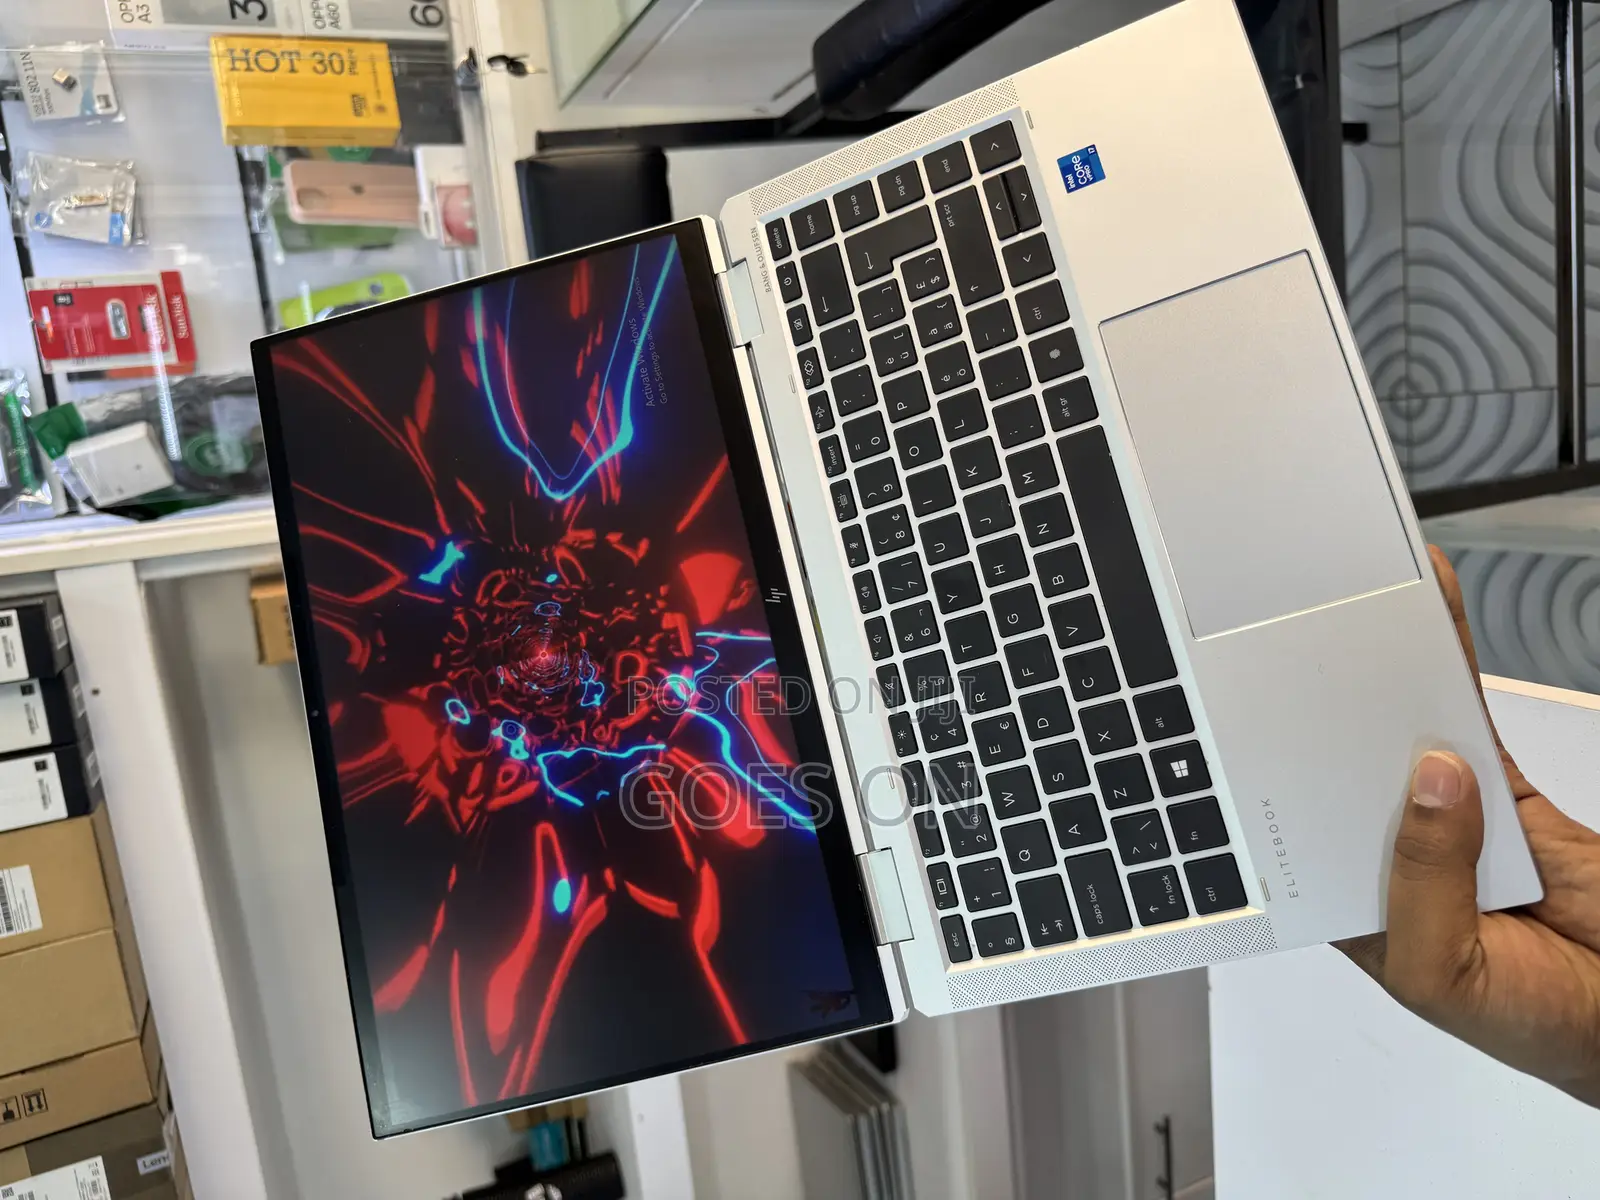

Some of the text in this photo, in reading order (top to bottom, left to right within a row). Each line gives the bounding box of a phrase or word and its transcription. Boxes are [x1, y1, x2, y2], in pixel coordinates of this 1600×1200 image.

[311, 0, 327, 30] OPP
[226, 48, 346, 75] HOT 30
[941, 158, 951, 173] end
[895, 175, 906, 196] pg dn
[1065, 173, 1076, 189] intel
[850, 194, 861, 216] pg up
[943, 204, 955, 227] prt scr
[806, 214, 816, 235] home
[773, 227, 783, 249] delete
[750, 227, 764, 262] OLUFSEN
[761, 270, 772, 293] BANG
[1032, 305, 1042, 320] ctrl
[651, 353, 664, 382] Settings
[640, 367, 655, 408] Activate
[657, 383, 665, 392] to
[660, 393, 668, 404] Go
[897, 402, 908, 411] P
[1059, 397, 1071, 417] alt gr
[954, 419, 965, 430] L
[827, 445, 838, 466] insert
[965, 465, 978, 478] K
[1022, 471, 1035, 485] M
[883, 483, 894, 493] 9
[895, 530, 906, 539] 8
[1036, 523, 1050, 535] N
[934, 542, 946, 554] U
[992, 564, 1006, 576] H
[907, 581, 919, 589] 7
[1052, 574, 1065, 585] B
[946, 594, 958, 603] Y
[1007, 613, 1019, 625] G
[904, 632, 914, 642] &
[920, 627, 931, 637] 6
[1065, 626, 1079, 637] V
[960, 644, 972, 653] T
[1021, 667, 1034, 677] F
[918, 680, 928, 691] %
[933, 677, 945, 687] 5
[1081, 676, 1094, 688] C
[974, 691, 987, 703] R
[1000, 720, 1010, 730] €
[1037, 717, 1050, 729] D
[1155, 716, 1165, 728] alt
[947, 728, 958, 737] 4
[1097, 730, 1112, 743] X
[988, 744, 1001, 755] E
[956, 760, 967, 768] #
[1052, 772, 1065, 782] S
[961, 780, 973, 790] 3
[1113, 787, 1128, 799] Z
[1001, 792, 1015, 808] W
[969, 813, 982, 826] @
[1068, 823, 1081, 835] A
[975, 832, 988, 843] 2
[1190, 830, 1198, 841] fn
[1260, 797, 1300, 899] ELITEBOOK
[1018, 848, 1031, 862] Q
[1162, 874, 1176, 905] fn lock
[1205, 886, 1217, 902] ctrl
[1086, 883, 1104, 925] caps lock
[951, 932, 960, 947] esc
[1004, 937, 1016, 946] §
